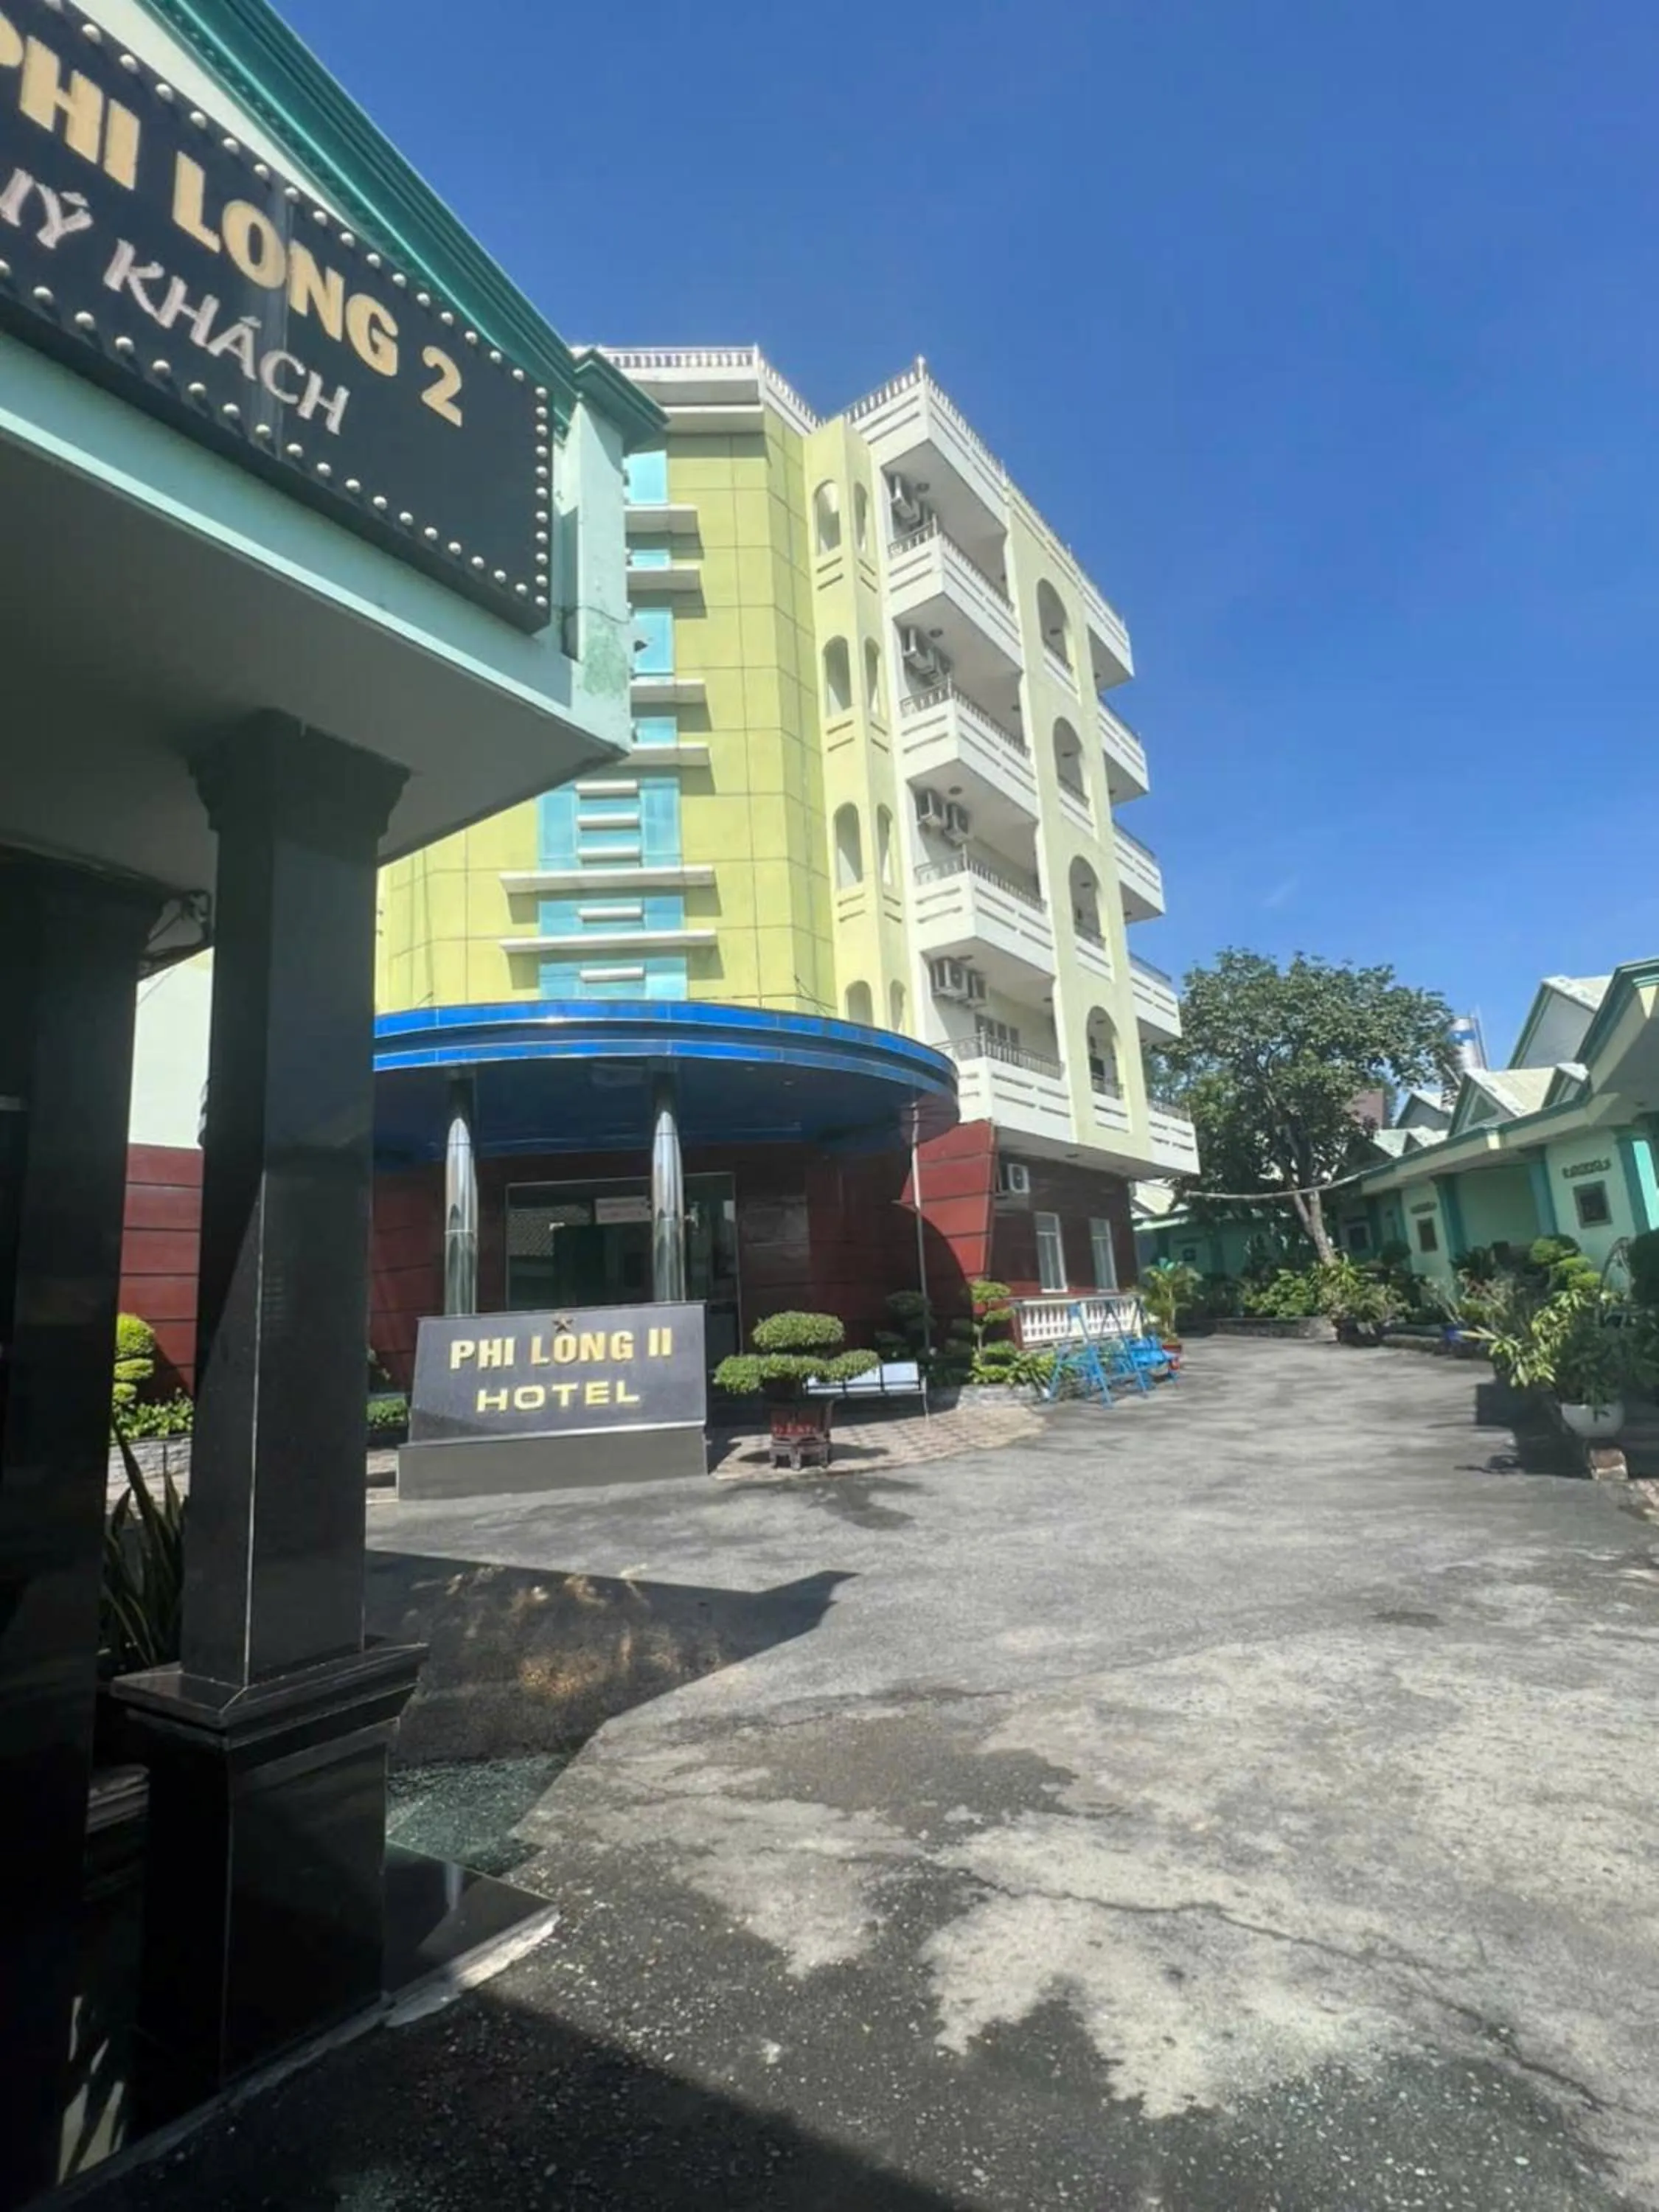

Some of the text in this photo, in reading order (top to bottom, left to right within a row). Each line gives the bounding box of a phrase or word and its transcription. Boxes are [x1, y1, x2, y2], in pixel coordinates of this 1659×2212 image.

[103, 238, 351, 436] KHÁCH
[173, 151, 400, 378] LONG
[422, 347, 463, 427] 2
[450, 1327, 672, 1370] PHI LONG II
[476, 1380, 640, 1413] HOTEL
